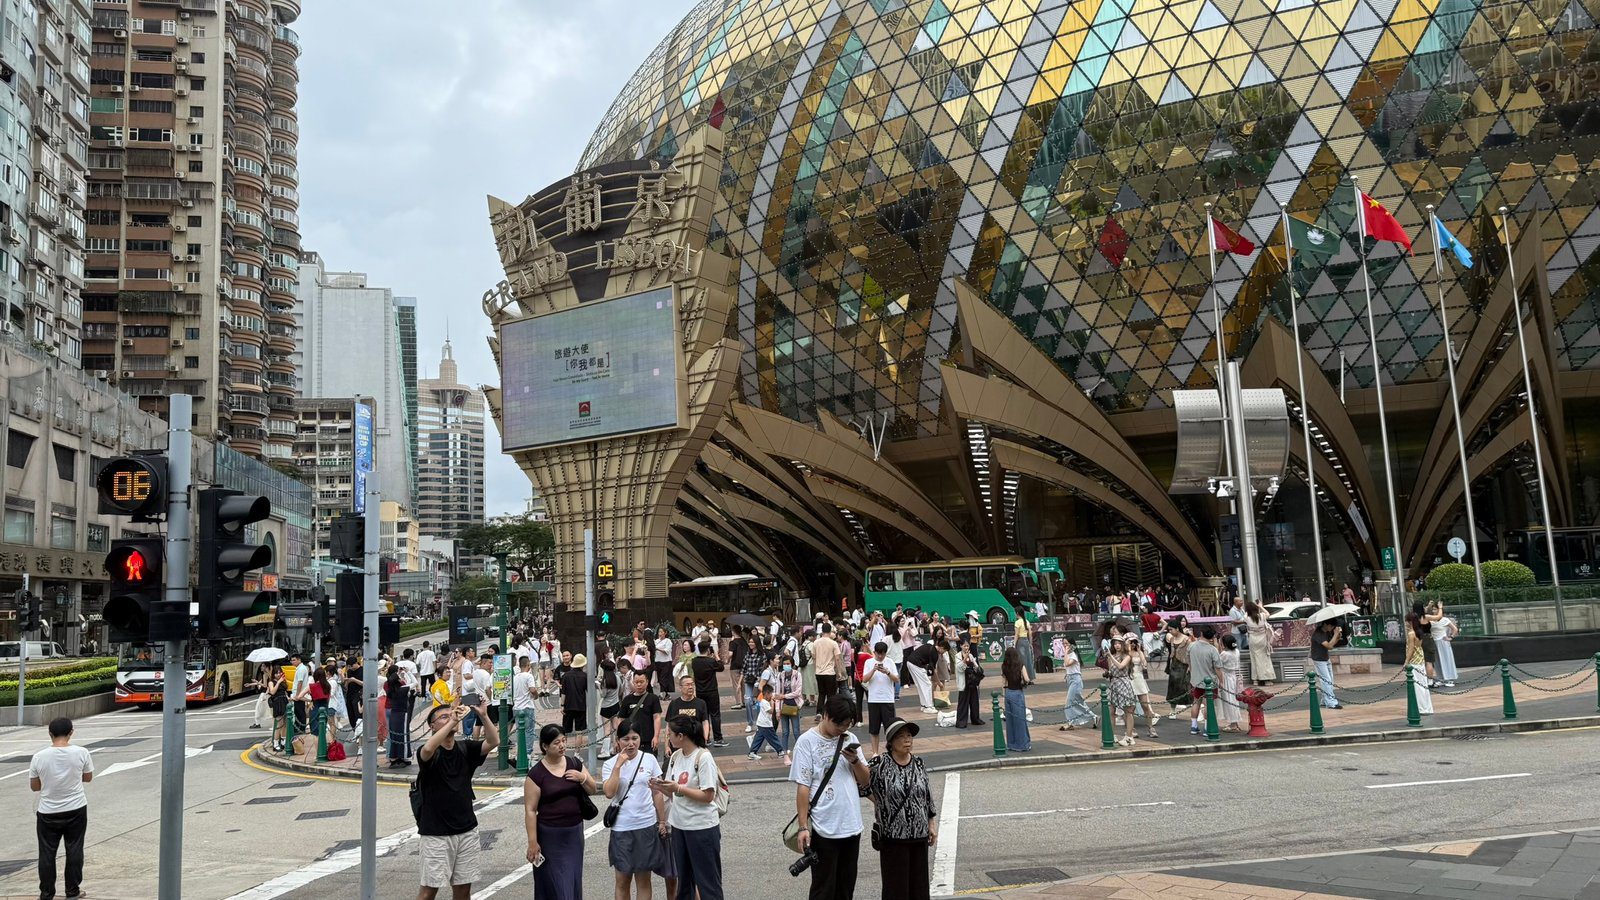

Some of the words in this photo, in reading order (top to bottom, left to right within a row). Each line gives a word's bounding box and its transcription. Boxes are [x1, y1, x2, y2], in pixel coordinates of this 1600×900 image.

[482, 252, 569, 318] GRAND
[595, 235, 692, 277] LISBOA
[554, 344, 589, 360] 旅遊大使
[113, 470, 152, 500] 06
[598, 565, 613, 577] 05
